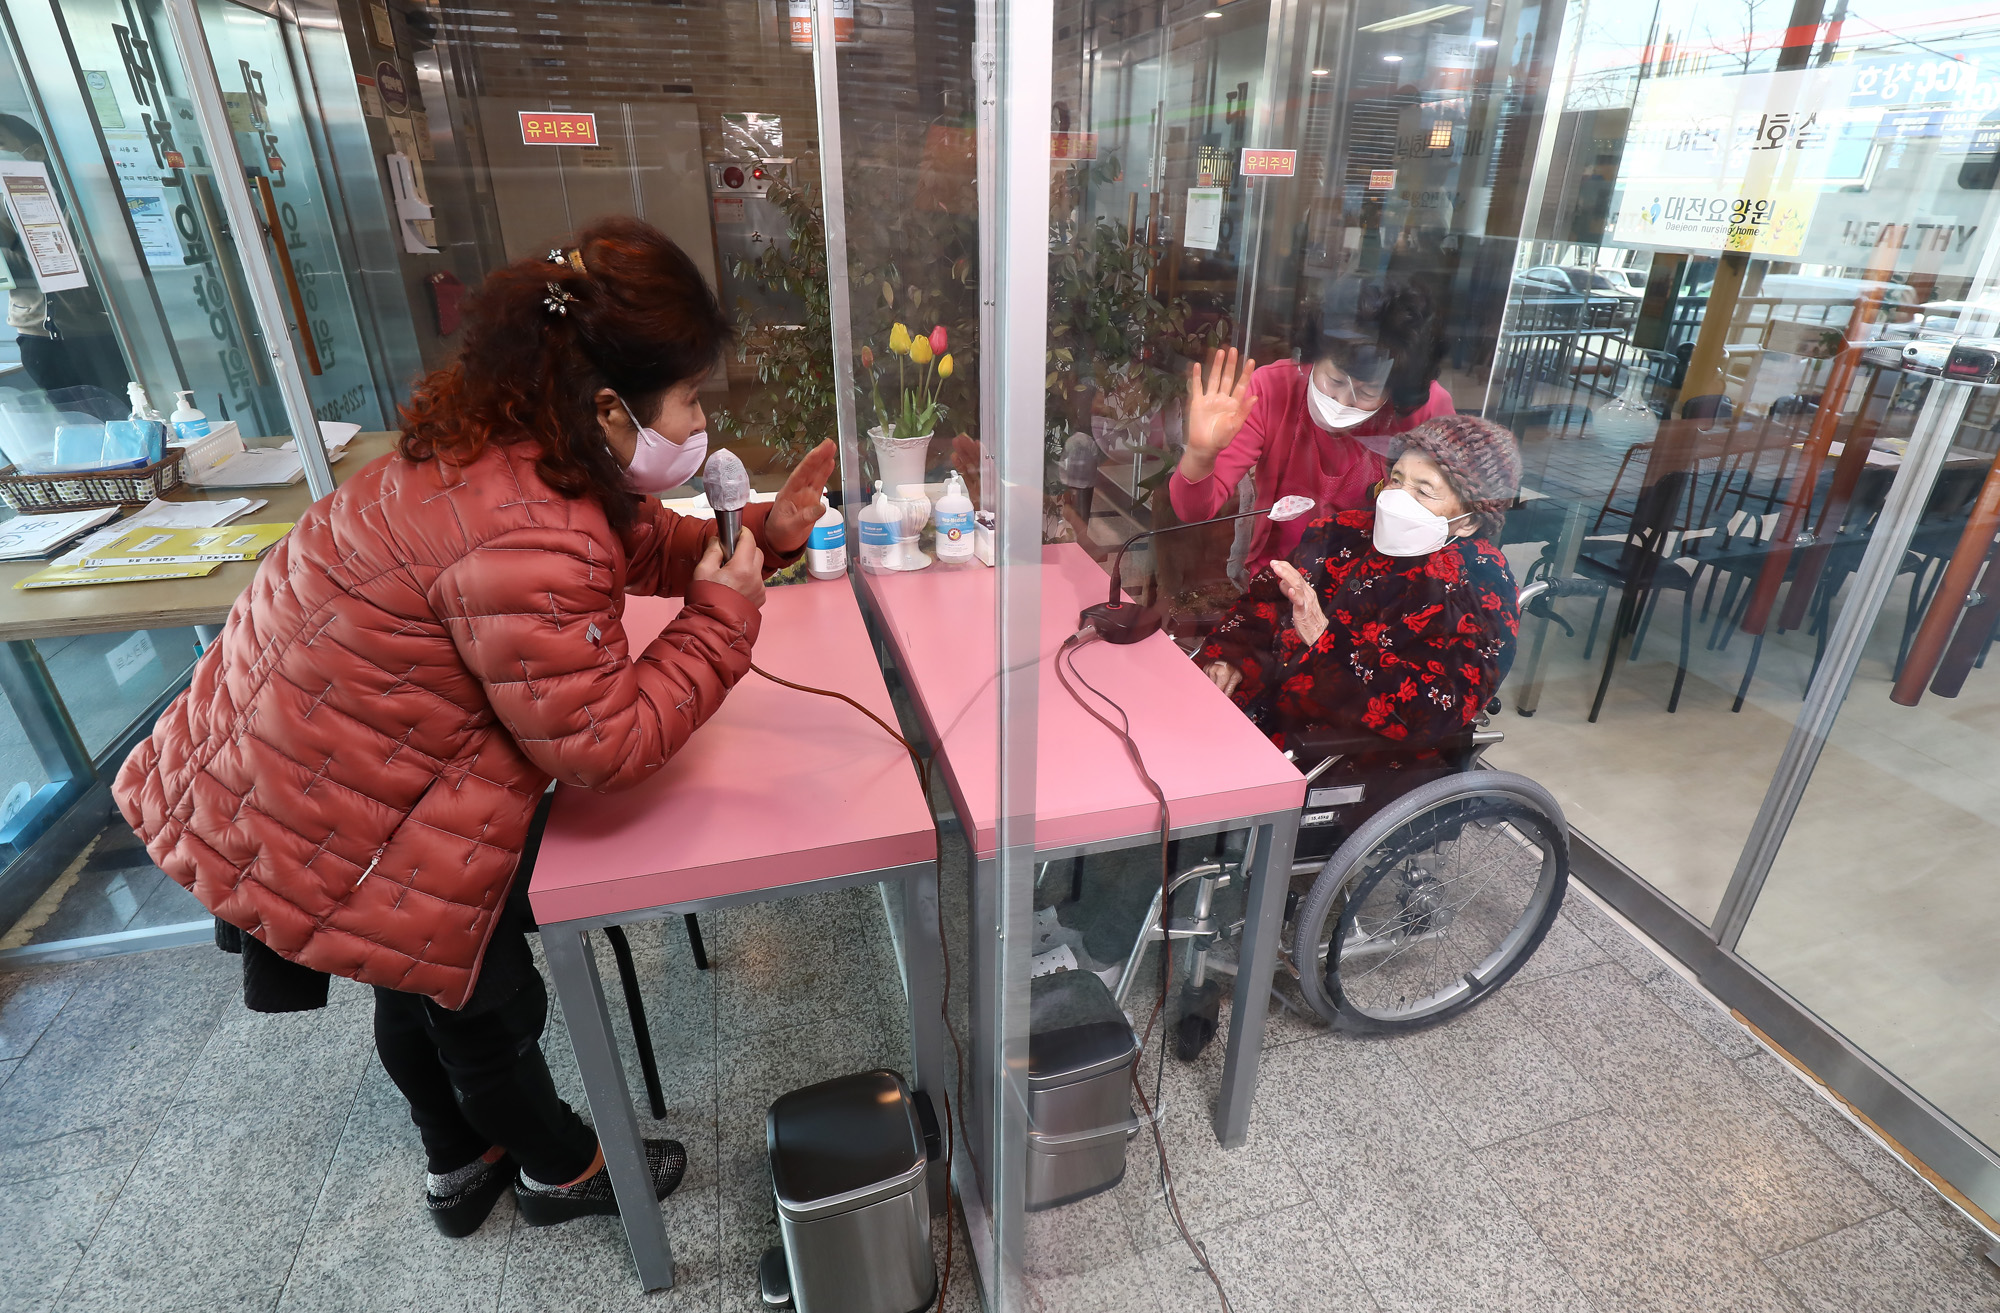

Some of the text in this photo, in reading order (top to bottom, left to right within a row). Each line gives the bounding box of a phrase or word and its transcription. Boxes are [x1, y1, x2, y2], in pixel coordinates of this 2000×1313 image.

[527, 119, 592, 139] 유리주의
[1247, 155, 1292, 170] 유리주의
[1664, 197, 1776, 226] 대전요양원
[1665, 221, 1760, 236] Daejeon nursing home
[1842, 220, 1978, 252] HEALTHY
